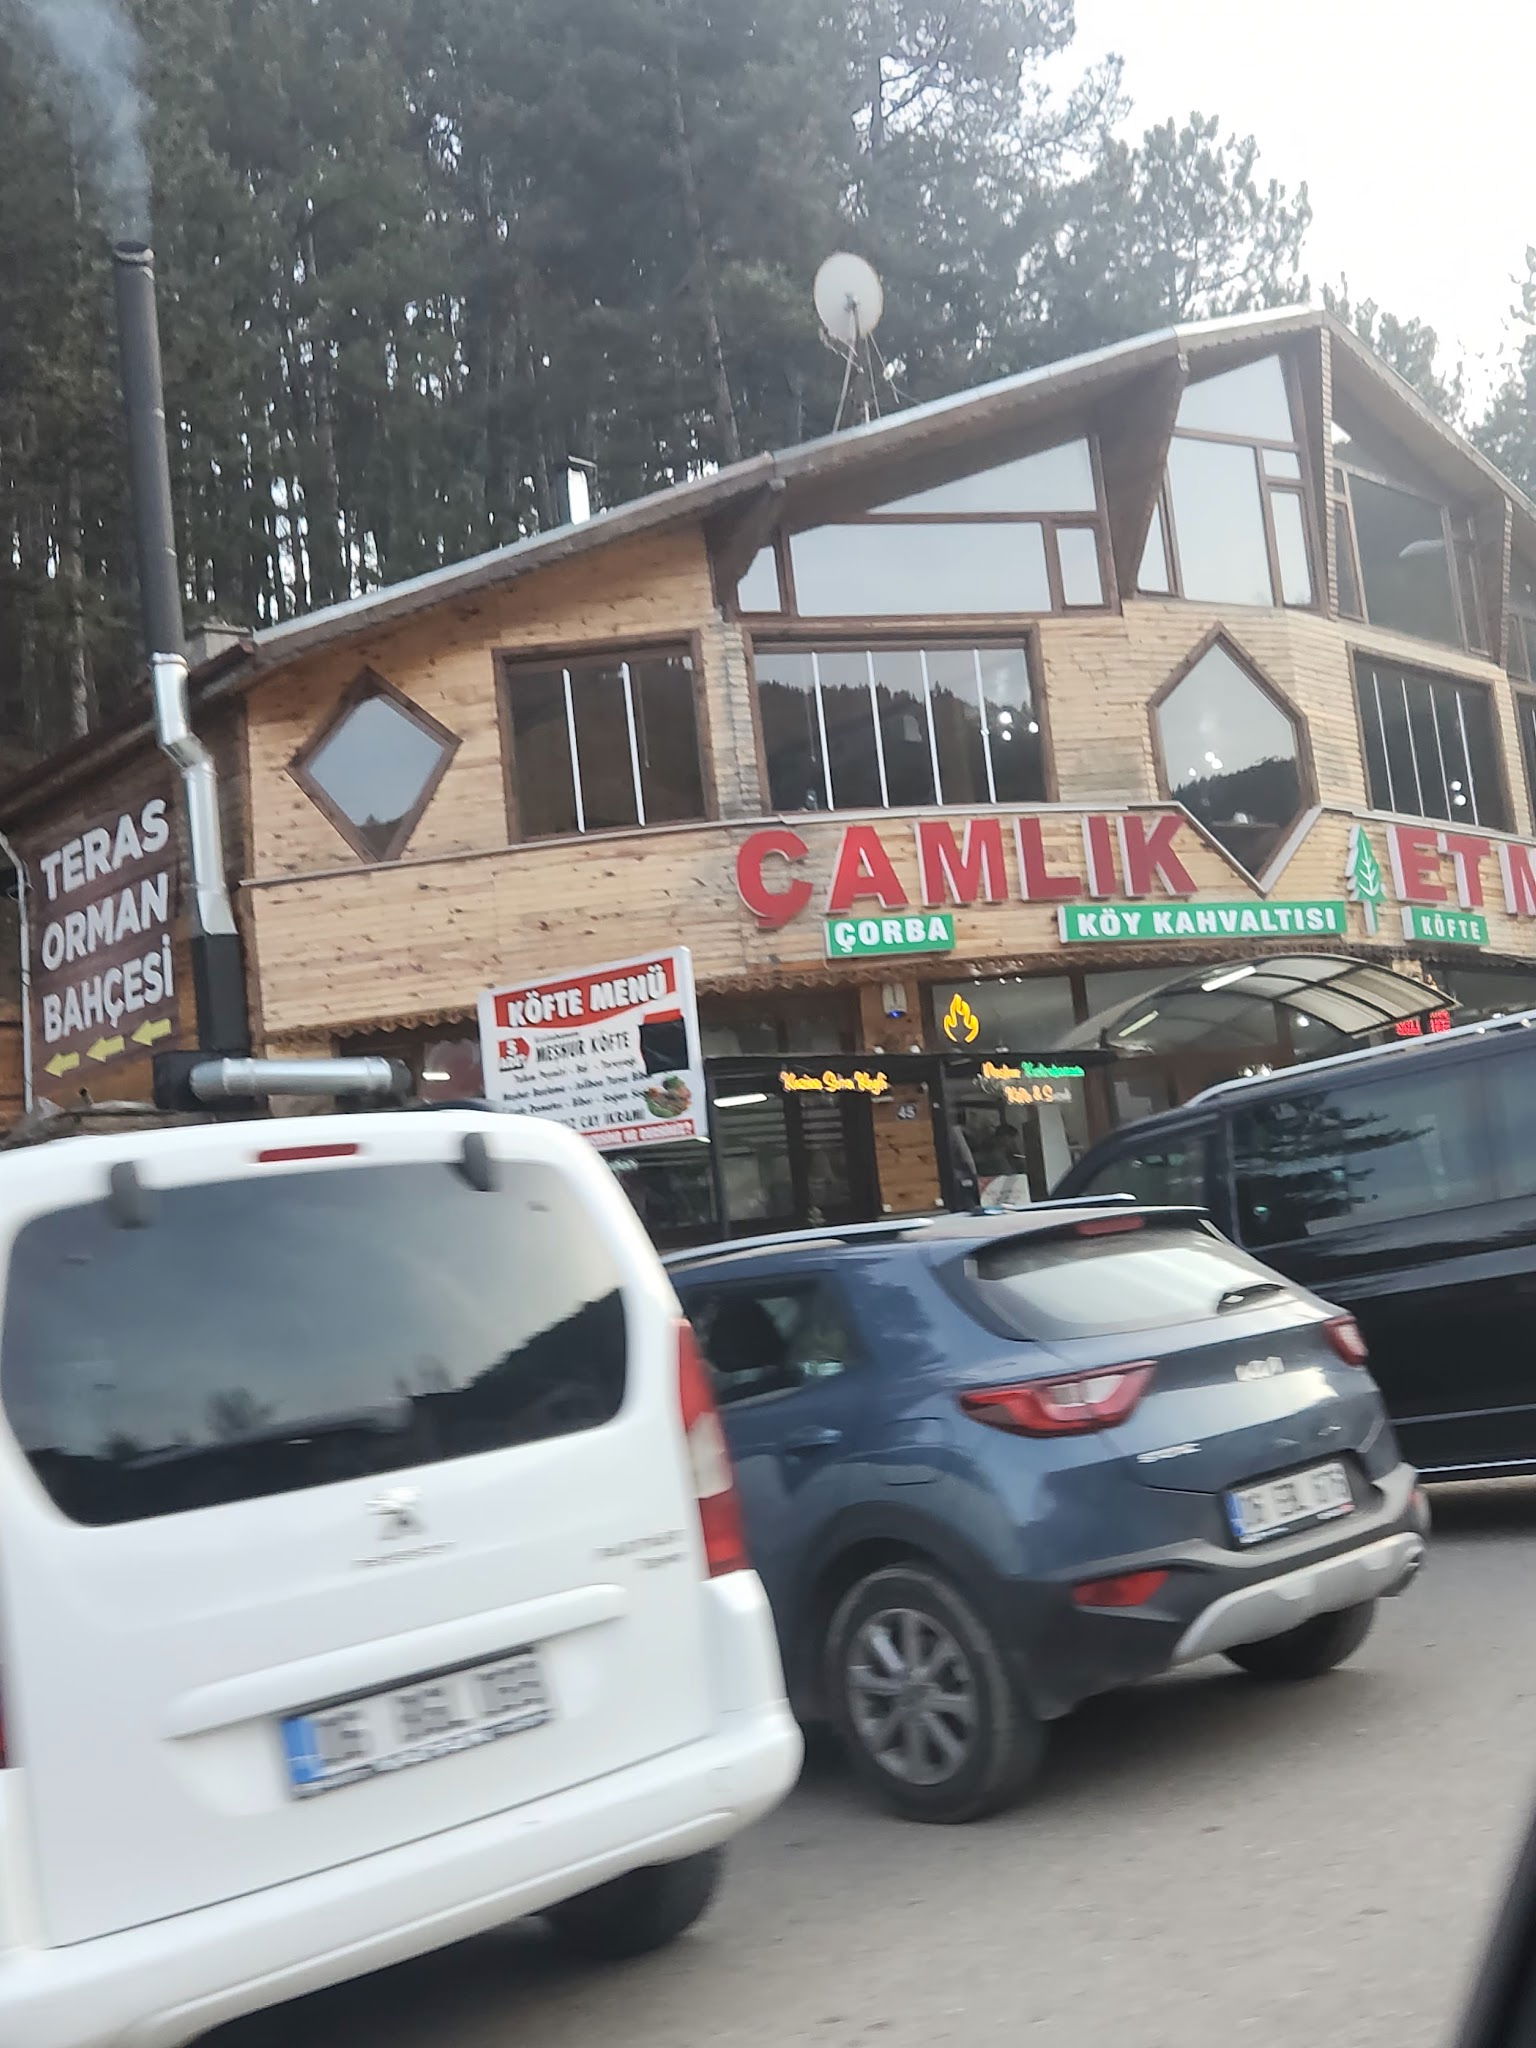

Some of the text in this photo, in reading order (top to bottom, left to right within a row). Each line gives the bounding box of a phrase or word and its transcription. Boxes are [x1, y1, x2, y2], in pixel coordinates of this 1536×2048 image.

[40, 799, 169, 900] TERAS
[736, 815, 1197, 931] ÇAMLIK
[1386, 824, 1491, 909] ET
[41, 872, 169, 971] ORMAN
[834, 915, 950, 954] ÇORBA
[1077, 907, 1337, 937] KÖY KAHVALTISI
[1420, 913, 1482, 941] KÖFTE
[43, 933, 174, 1043] BAHÇESİ
[507, 962, 667, 1027] KÖFTE MENÜ
